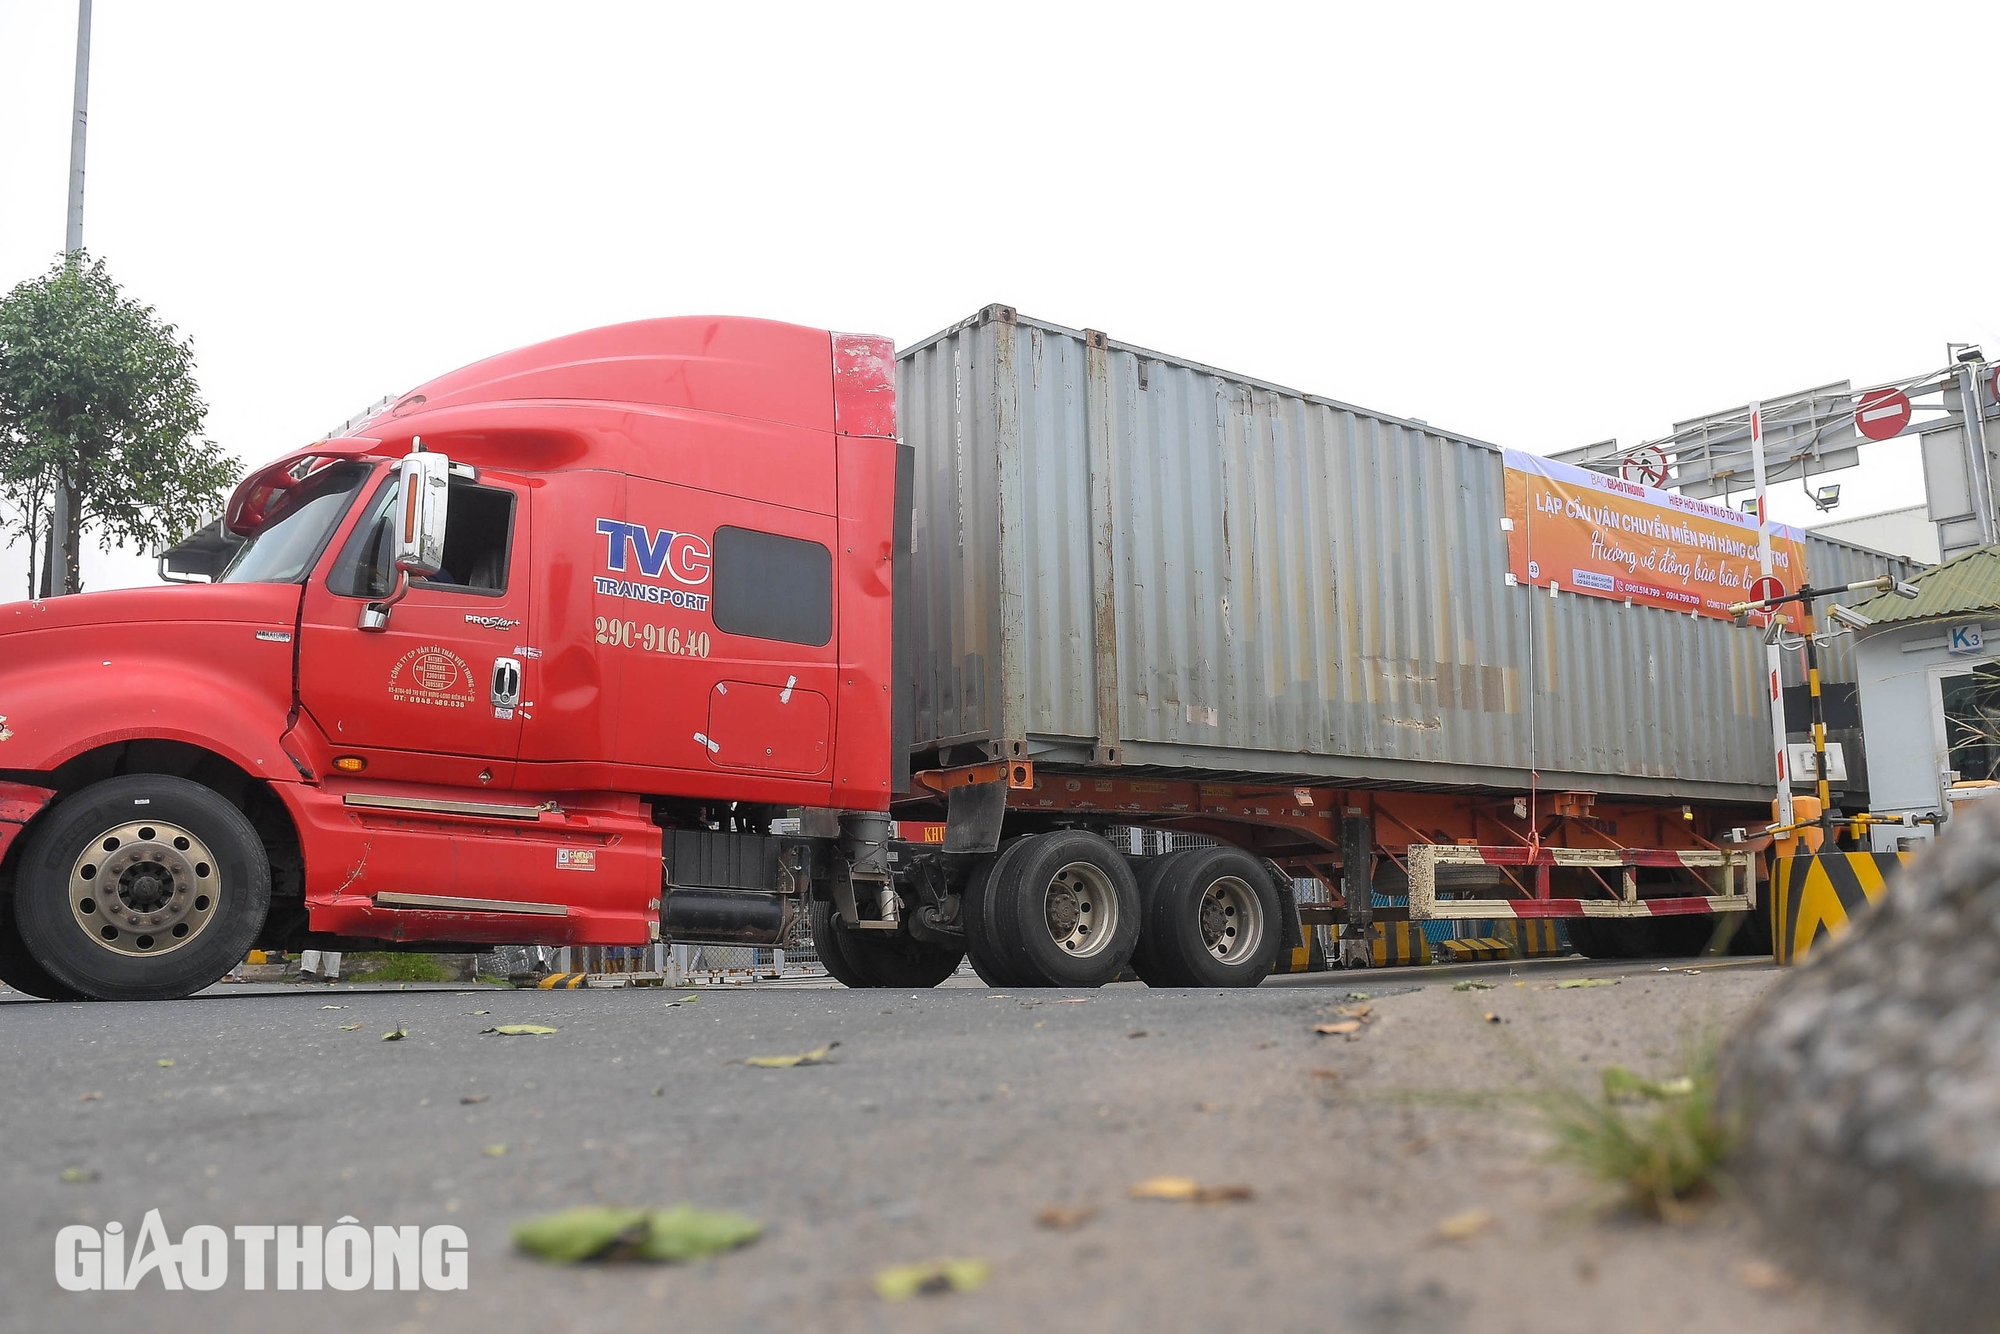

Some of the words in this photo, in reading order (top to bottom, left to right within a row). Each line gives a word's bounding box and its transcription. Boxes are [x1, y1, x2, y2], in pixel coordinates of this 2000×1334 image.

[1535, 491, 1562, 519] LẬP
[1594, 505, 1620, 532] VẬN
[1622, 514, 1669, 541] CHUYỂN
[1670, 521, 1699, 548] MIỄN
[1699, 532, 1717, 551] PHÍ
[1718, 535, 1746, 559] HÀNG
[1747, 541, 1761, 561] CỨ
[1735, 512, 1744, 523] VN
[596, 517, 711, 585] TVC
[1591, 529, 1638, 574] Hướng
[1640, 547, 1657, 570] về
[1658, 547, 1692, 586] đồng
[1694, 554, 1717, 583] bào
[593, 576, 710, 612] TRANSPORT
[595, 616, 711, 659] 29C-916.40
[1952, 626, 1980, 649] K3
